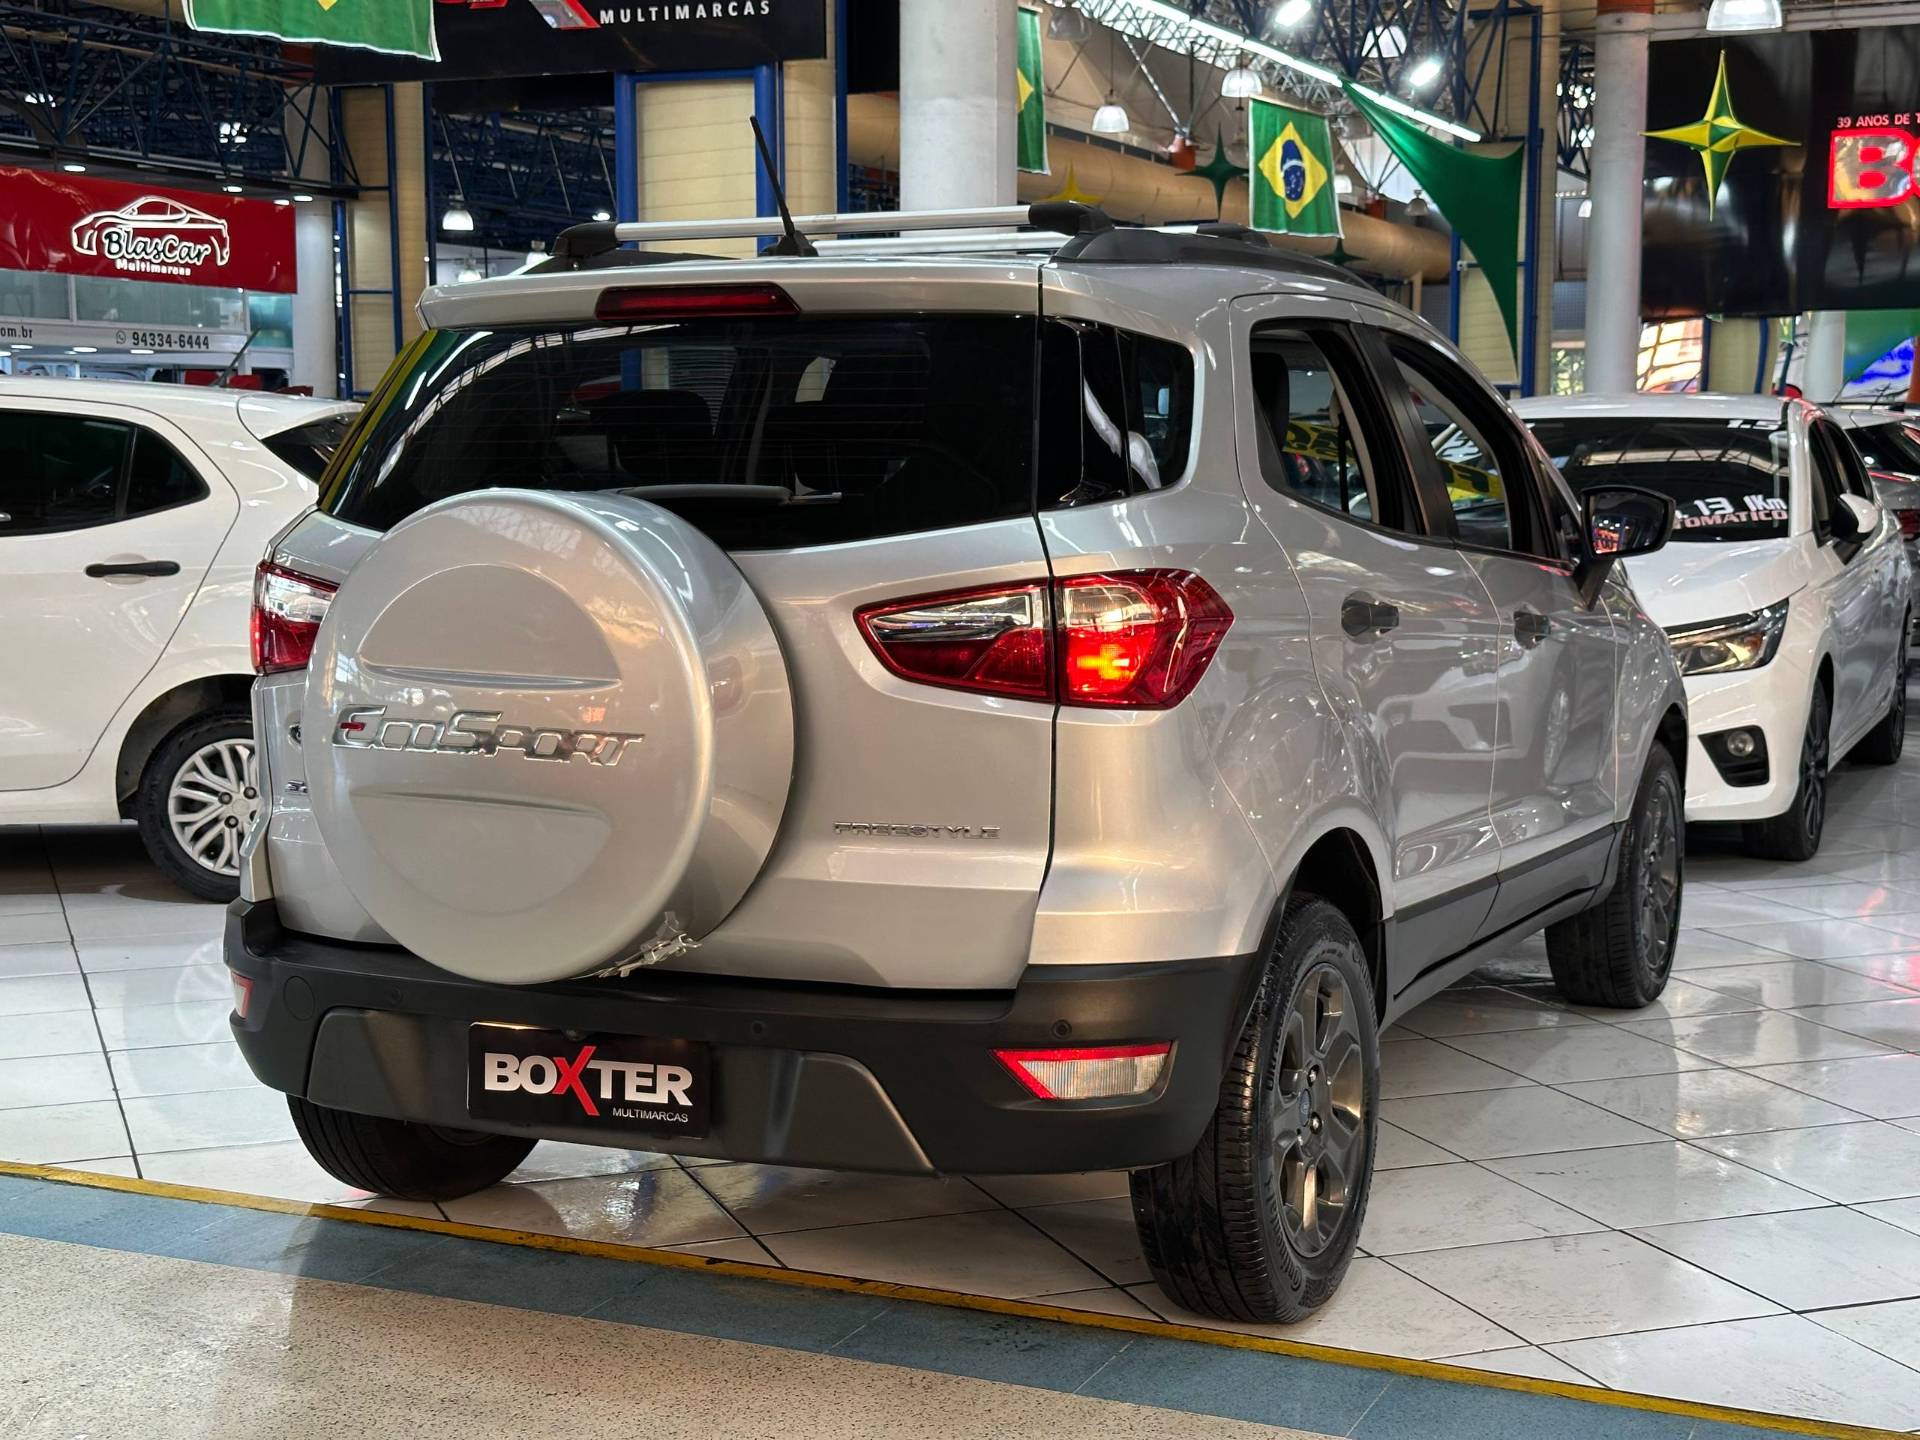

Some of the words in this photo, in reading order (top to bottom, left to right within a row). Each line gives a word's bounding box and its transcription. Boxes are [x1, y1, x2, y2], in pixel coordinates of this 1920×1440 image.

[600, 0, 770, 24] MULTIMARCAS
[1837, 117, 1851, 128] 39
[1856, 114, 1889, 127] ANOS
[1893, 113, 1910, 125] DE
[102, 227, 212, 266] BlasCar
[132, 331, 210, 349] 94334-6444
[1693, 496, 1735, 516] 13
[834, 822, 1001, 839] FREESTYLE
[485, 1046, 693, 1117] BOXTER
[612, 1107, 689, 1123] MULTIMARCAS
